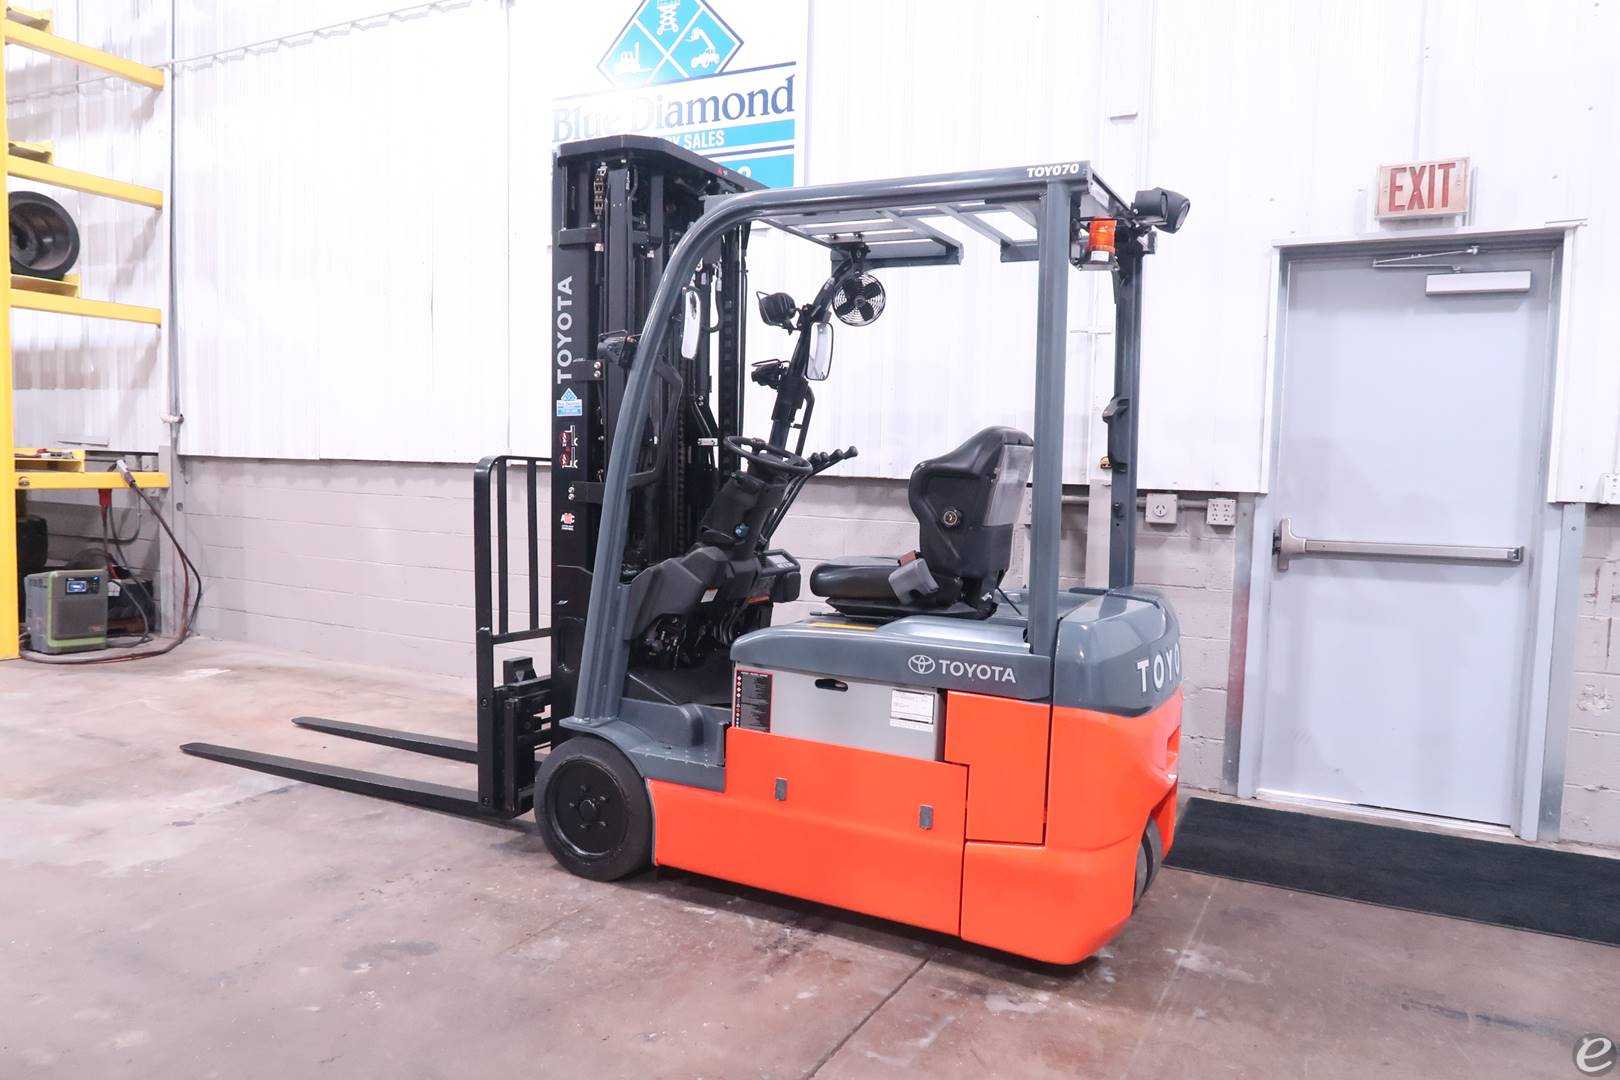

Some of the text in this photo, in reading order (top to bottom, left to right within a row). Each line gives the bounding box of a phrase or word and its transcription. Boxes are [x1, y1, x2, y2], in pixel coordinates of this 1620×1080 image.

[552, 74, 796, 143] Blue Diamond
[684, 130, 725, 149] SALES
[1389, 162, 1456, 212] EXIT
[557, 275, 573, 385] TOYOTA
[938, 659, 1017, 684] TOYOTA
